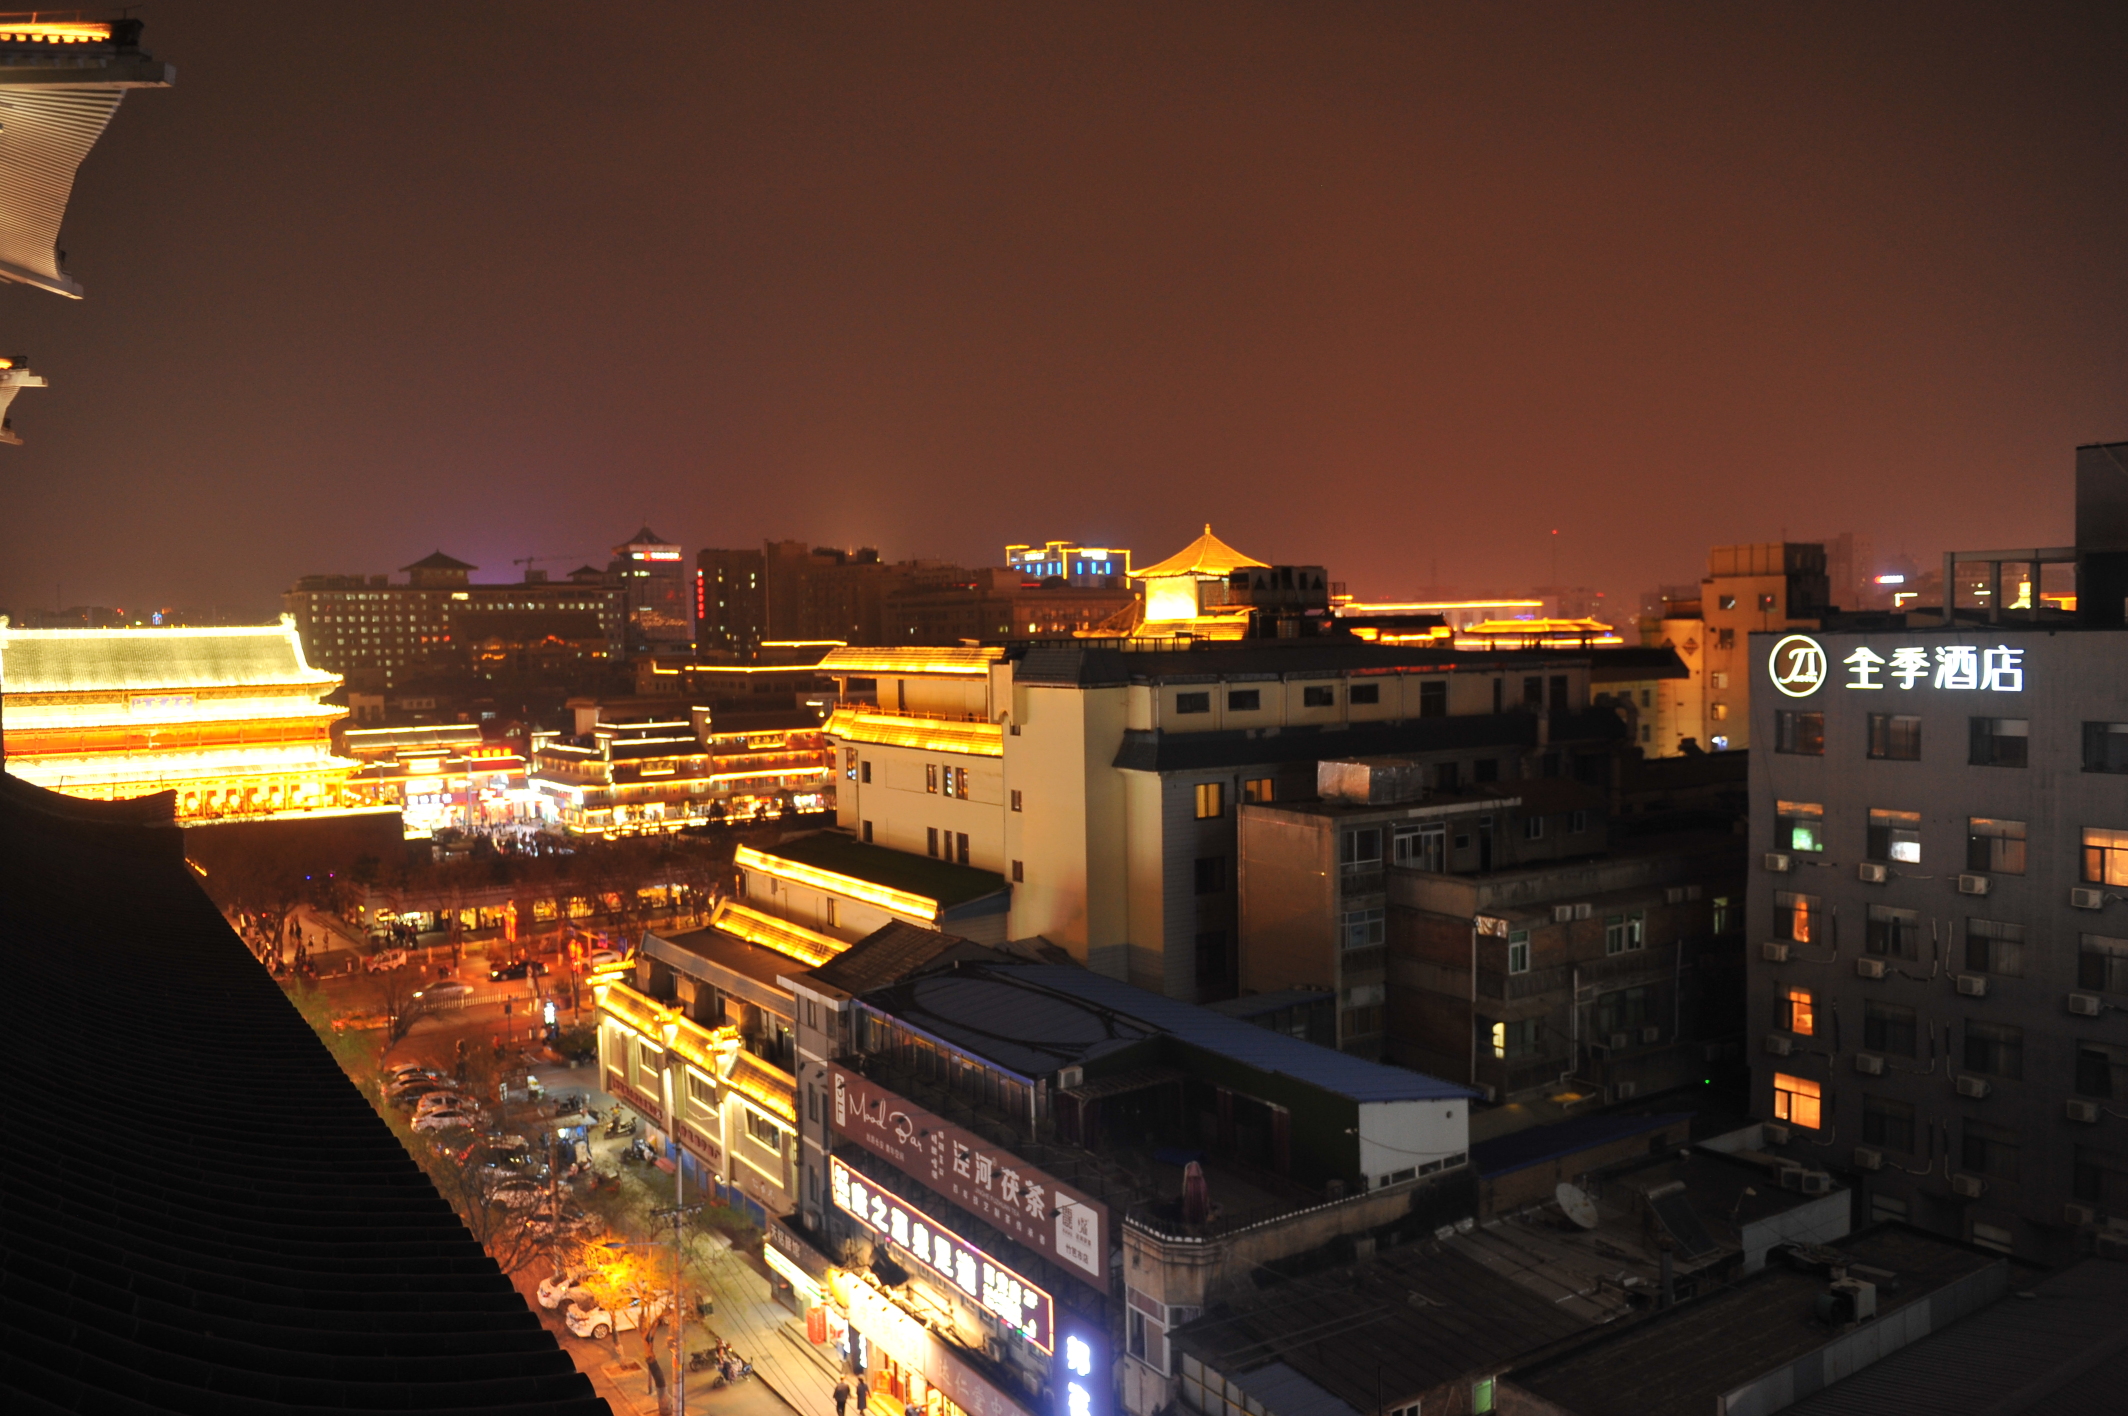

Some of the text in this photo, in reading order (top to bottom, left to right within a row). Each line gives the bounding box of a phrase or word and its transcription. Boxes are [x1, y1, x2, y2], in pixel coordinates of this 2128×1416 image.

[1843, 645, 2025, 692] 全季酒店
[849, 1092, 923, 1153] Mood Bar
